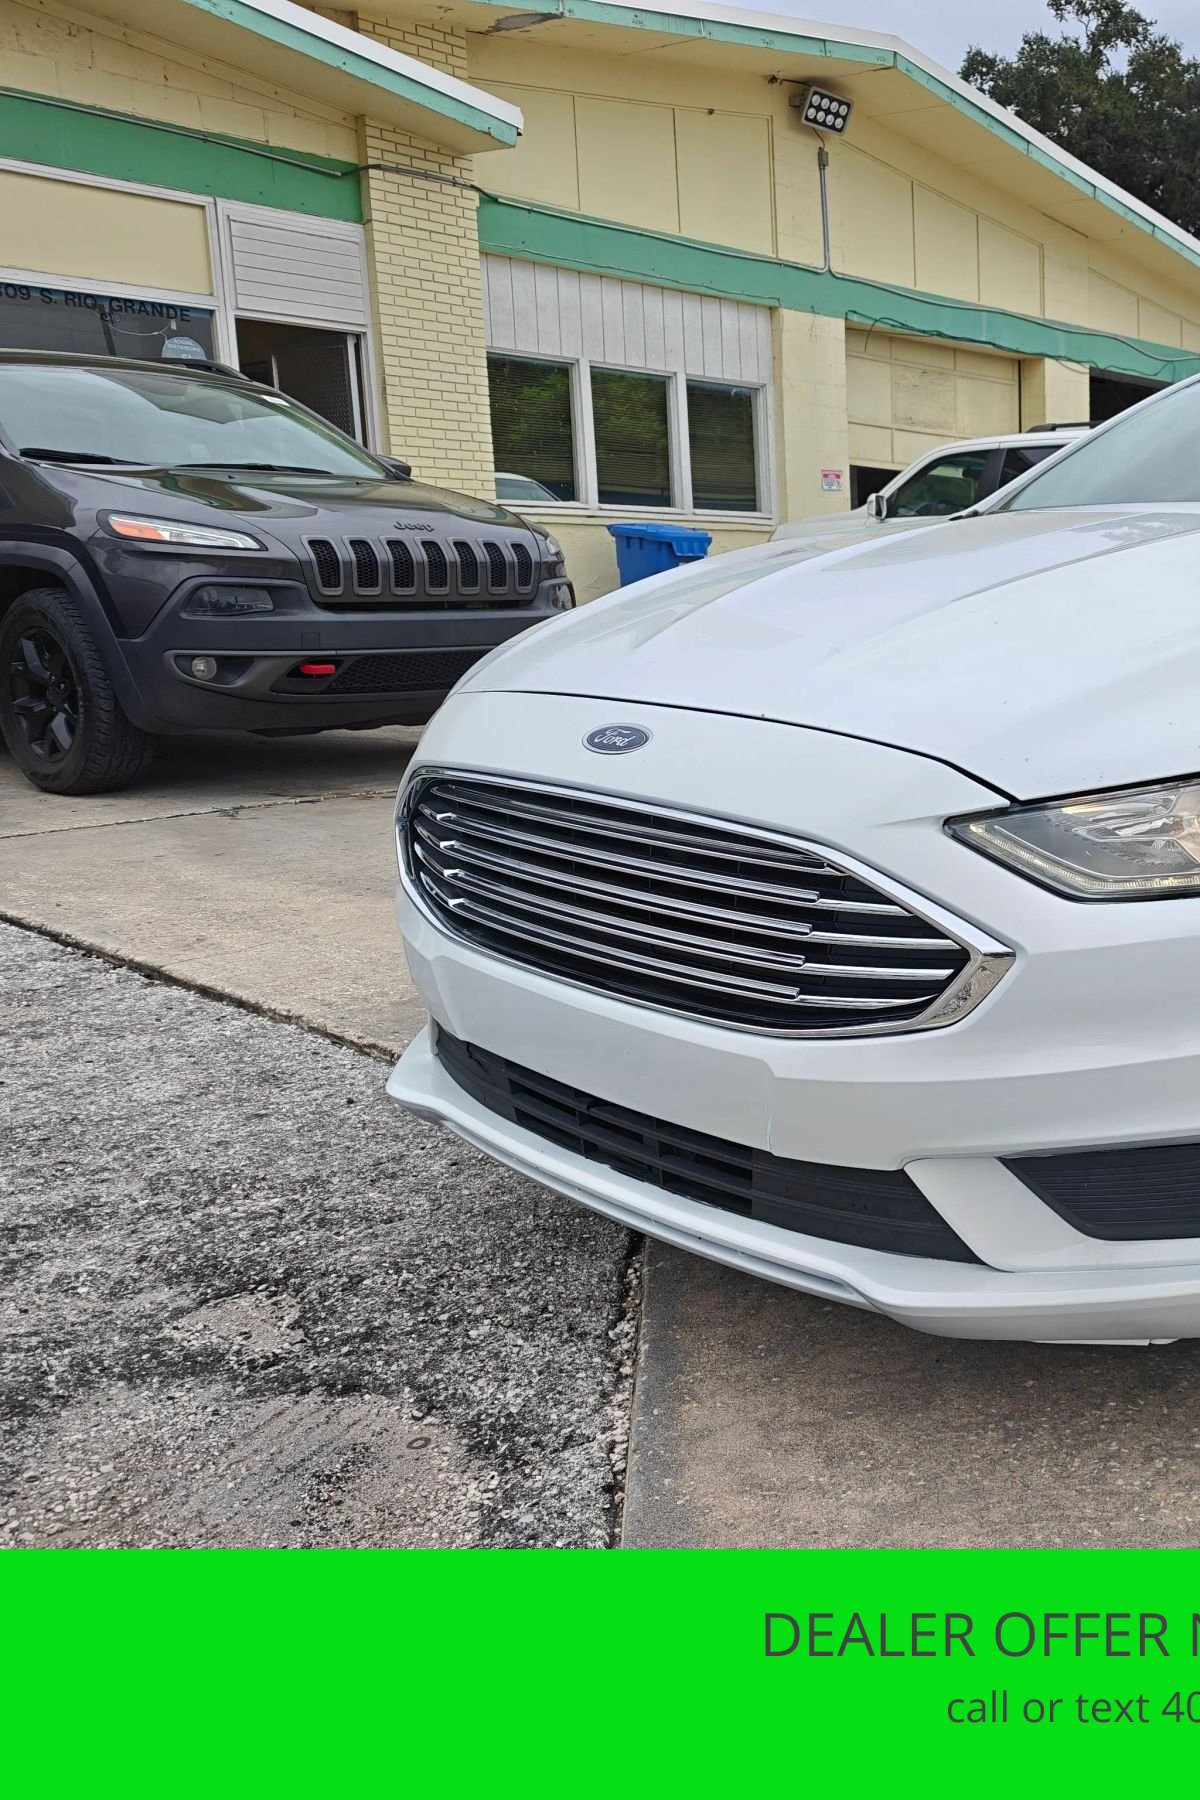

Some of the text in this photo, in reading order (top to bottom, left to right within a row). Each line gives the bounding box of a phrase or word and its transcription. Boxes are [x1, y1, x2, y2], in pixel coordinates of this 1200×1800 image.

[0, 284, 191, 322] 09 S. RIO GRANDE
[393, 520, 435, 533] Jeep
